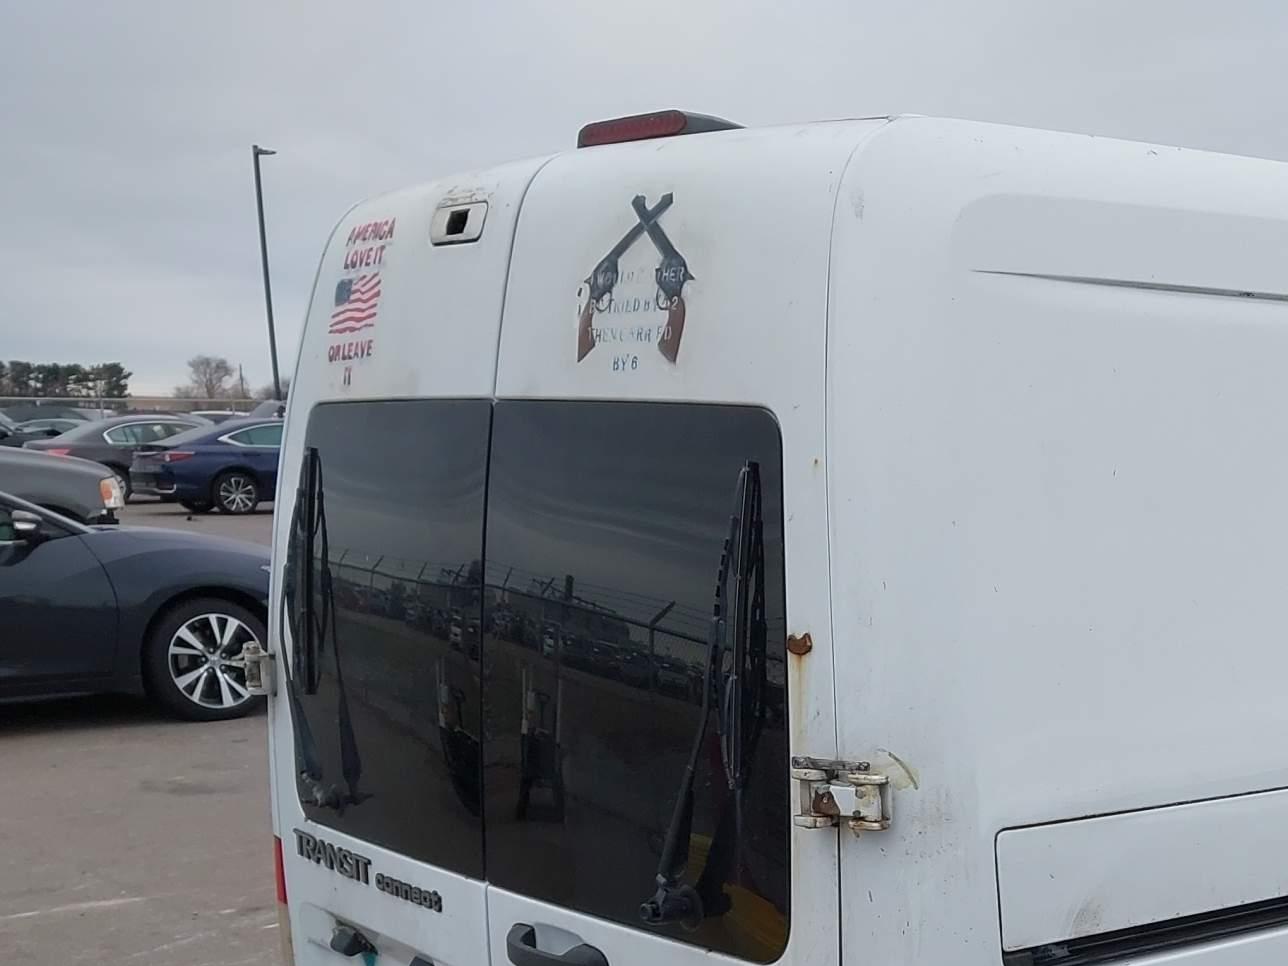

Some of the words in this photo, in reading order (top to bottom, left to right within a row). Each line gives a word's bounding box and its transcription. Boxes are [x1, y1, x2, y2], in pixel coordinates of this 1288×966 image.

[346, 217, 396, 247] AMERICA
[343, 247, 374, 270] LOVE
[373, 245, 387, 265] IT
[341, 339, 374, 361] LEAVE
[612, 355, 626, 371] BY
[631, 356, 638, 370] 6
[293, 828, 372, 885] TRANSIT
[375, 872, 443, 913] connect
